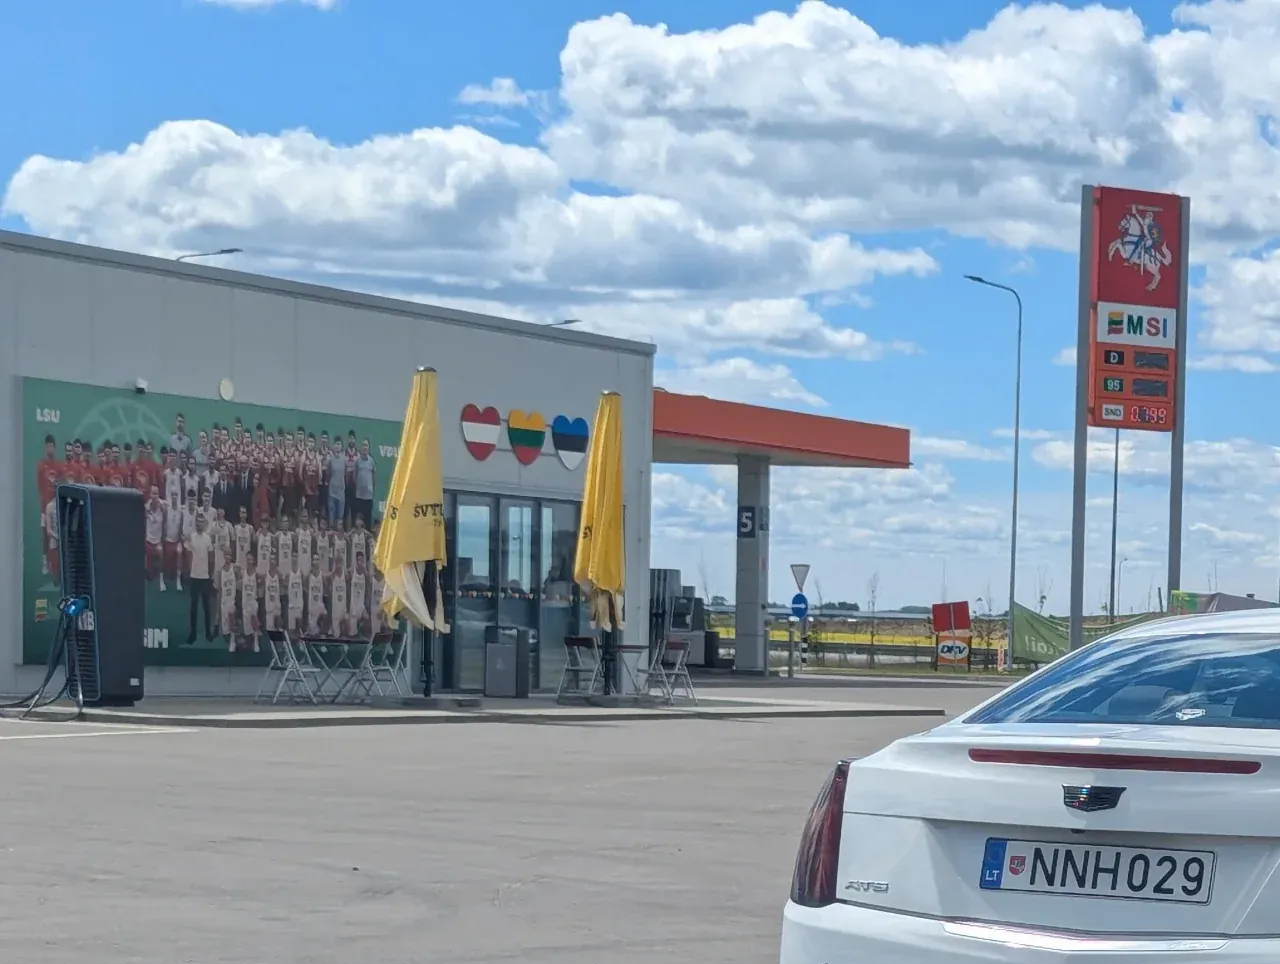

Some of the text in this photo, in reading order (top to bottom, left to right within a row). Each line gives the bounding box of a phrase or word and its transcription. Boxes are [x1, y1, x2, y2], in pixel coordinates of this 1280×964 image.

[1110, 352, 1119, 363] D
[1107, 379, 1120, 391] 95
[36, 407, 60, 423] LSU
[740, 511, 753, 533] 5
[984, 869, 1001, 881] LT
